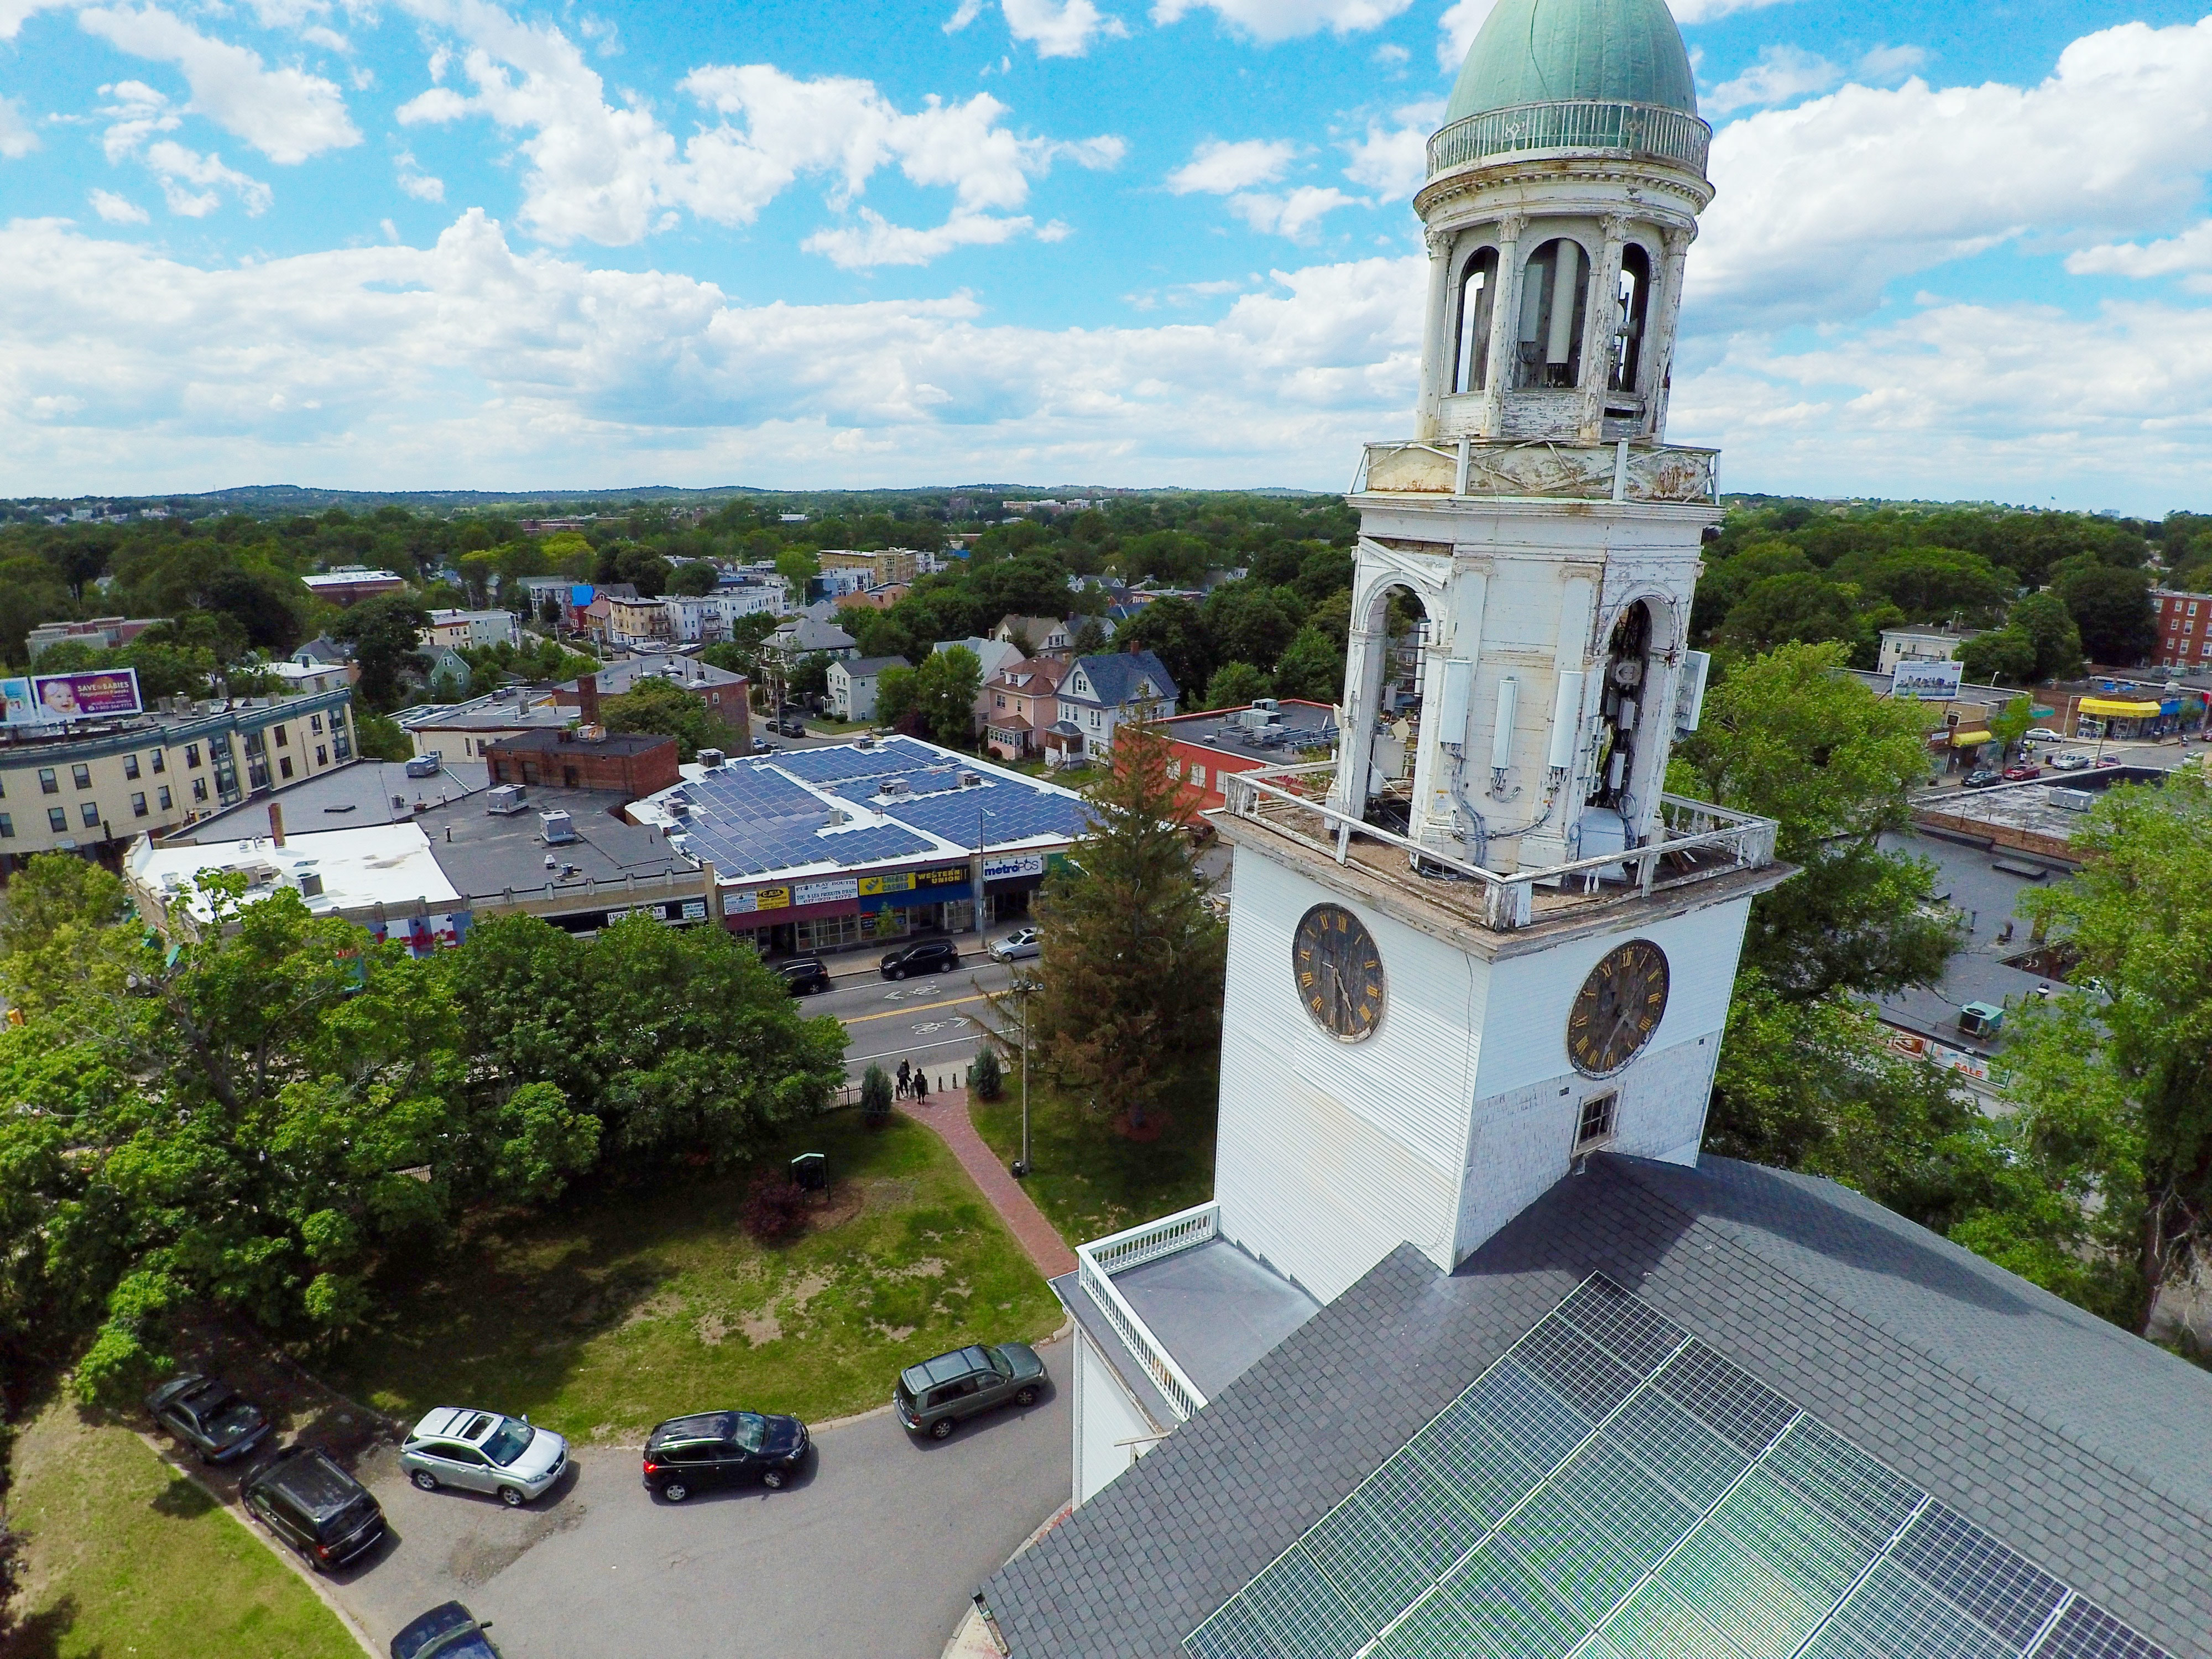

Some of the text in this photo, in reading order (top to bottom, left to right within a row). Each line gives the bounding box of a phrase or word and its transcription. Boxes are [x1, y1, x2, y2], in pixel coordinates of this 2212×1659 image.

[918, 869, 961, 880] WESTERN
[984, 860, 1039, 876] metroPCS
[931, 875, 961, 884] UNION
[1954, 1061, 1983, 1078] SALE
